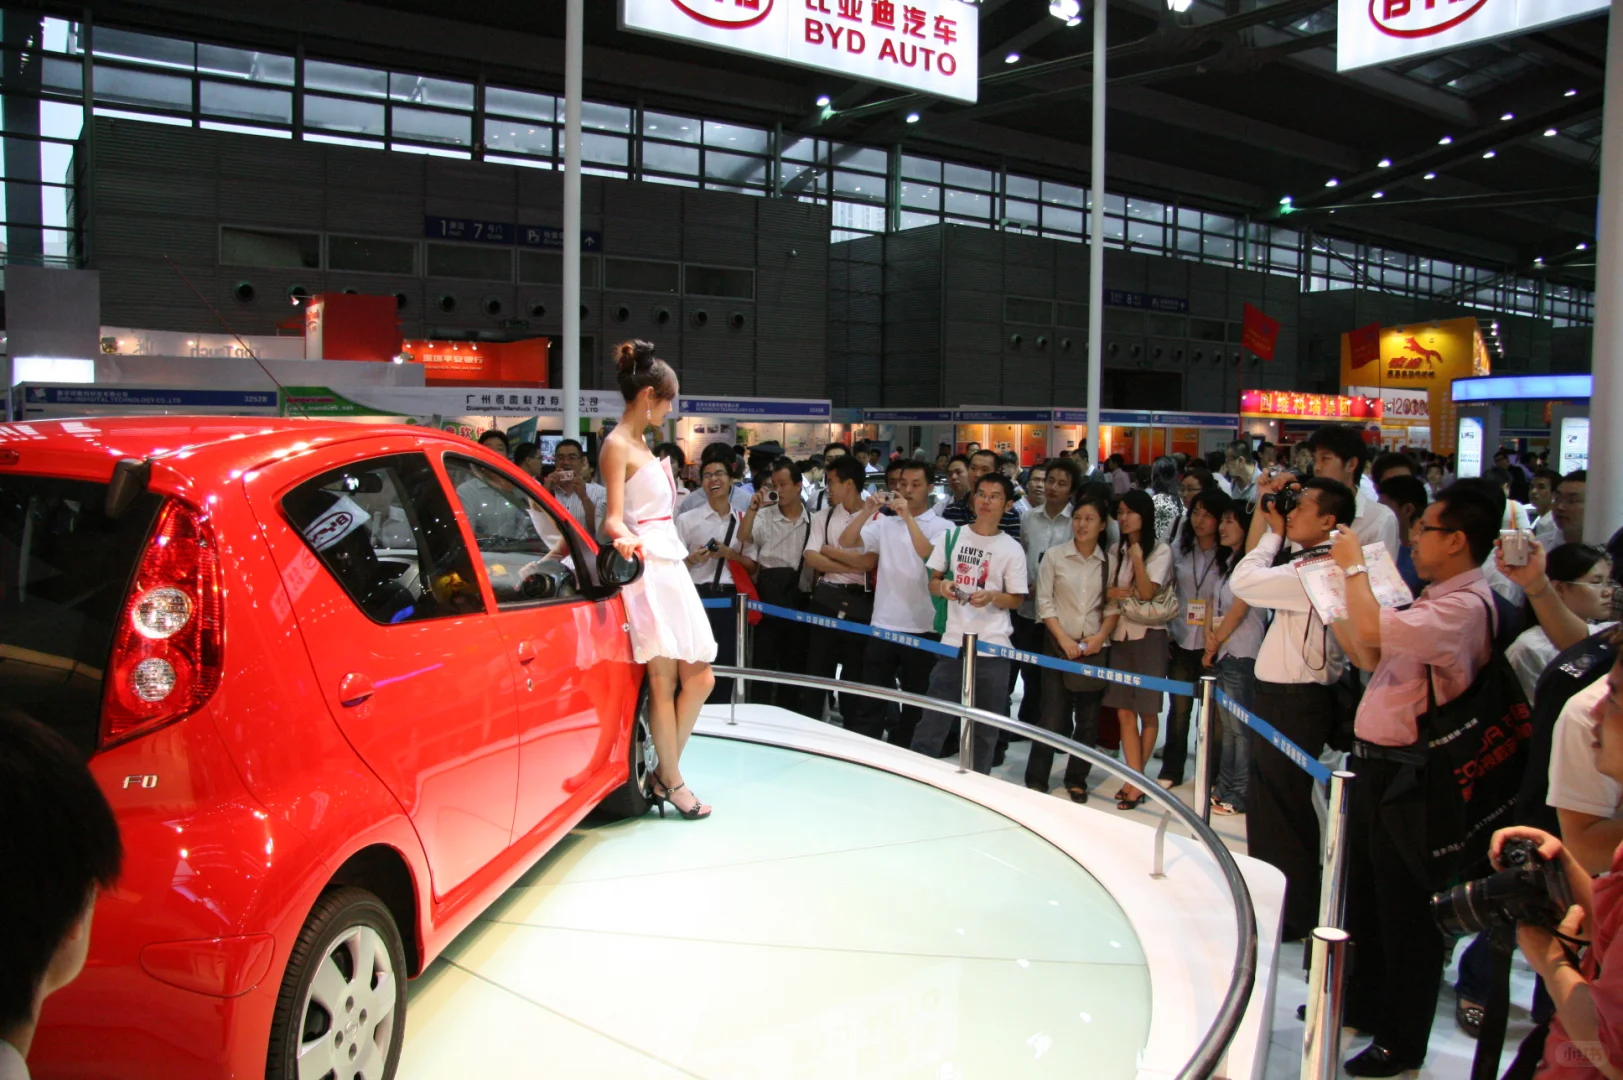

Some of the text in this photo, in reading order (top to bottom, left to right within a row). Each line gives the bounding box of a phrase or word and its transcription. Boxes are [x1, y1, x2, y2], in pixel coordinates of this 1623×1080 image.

[805, 18, 957, 76] BYD AUTO
[473, 223, 483, 239] 7
[957, 554, 981, 566] MILLION
[960, 546, 984, 558] LEVI'S
[956, 574, 976, 586] 501
[884, 631, 920, 647] 比亚迪汽车
[1001, 648, 1038, 664] 比亚迪汽车
[1097, 669, 1141, 686] 比亚迪汽车
